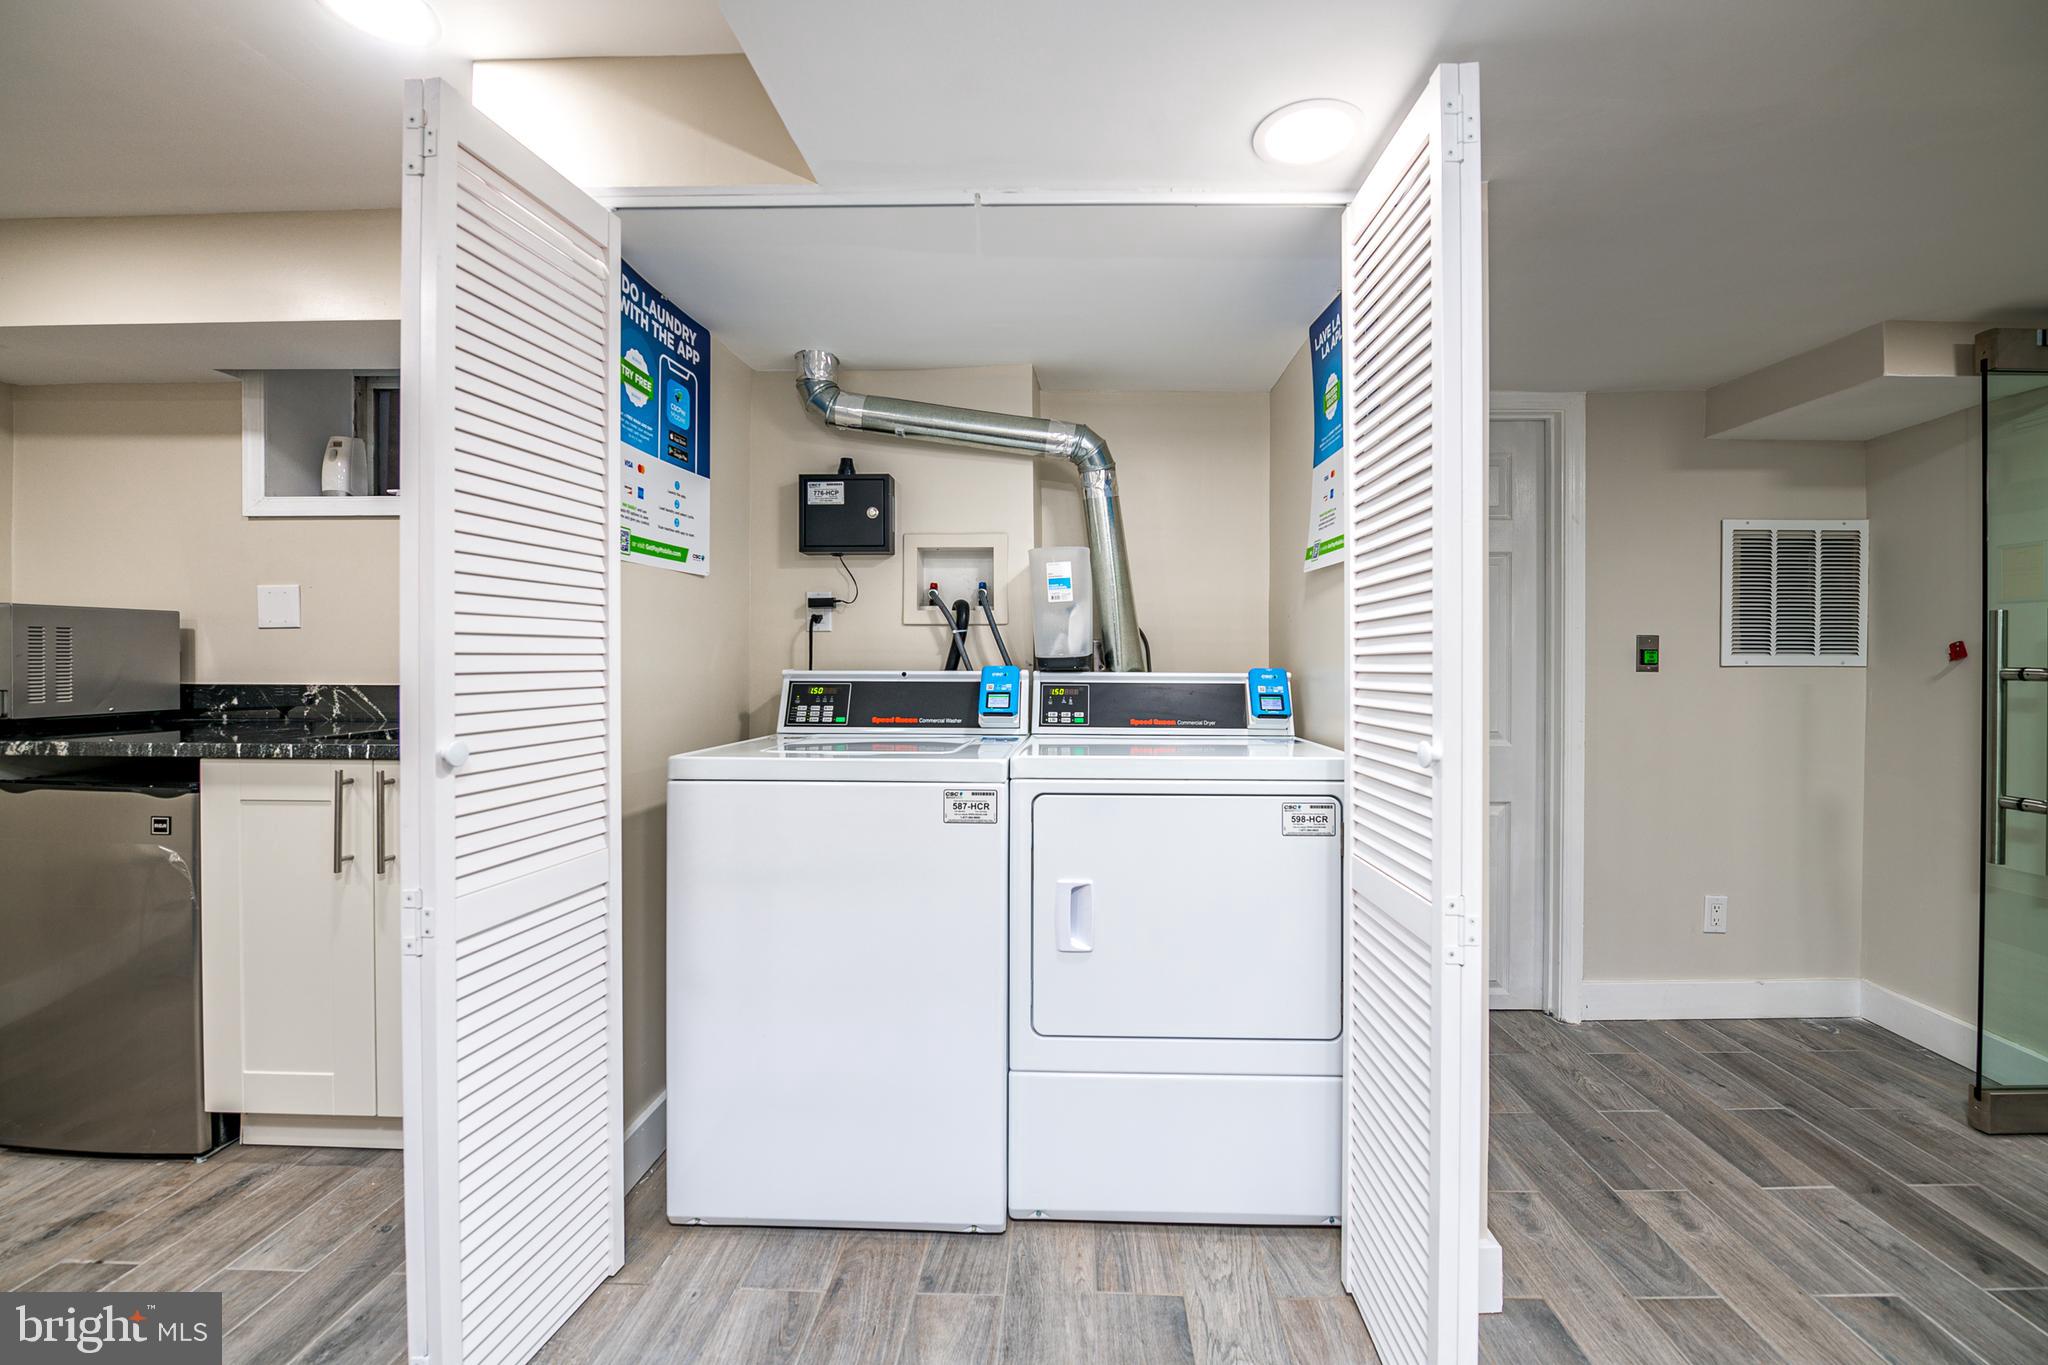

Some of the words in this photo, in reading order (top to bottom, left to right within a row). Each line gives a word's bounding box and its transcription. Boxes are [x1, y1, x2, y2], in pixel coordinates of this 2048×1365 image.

[621, 273, 639, 302] DO
[642, 291, 697, 346] LAUNDRY
[620, 295, 649, 332] WITH
[651, 319, 675, 351] THE
[677, 341, 700, 365] APP
[1314, 322, 1331, 352] LAVE
[1321, 341, 1331, 360] LA
[621, 364, 634, 381] TRY
[634, 372, 652, 393] FREE
[952, 802, 990, 811] 587-HCR
[1291, 815, 1329, 823] 598-HCR
